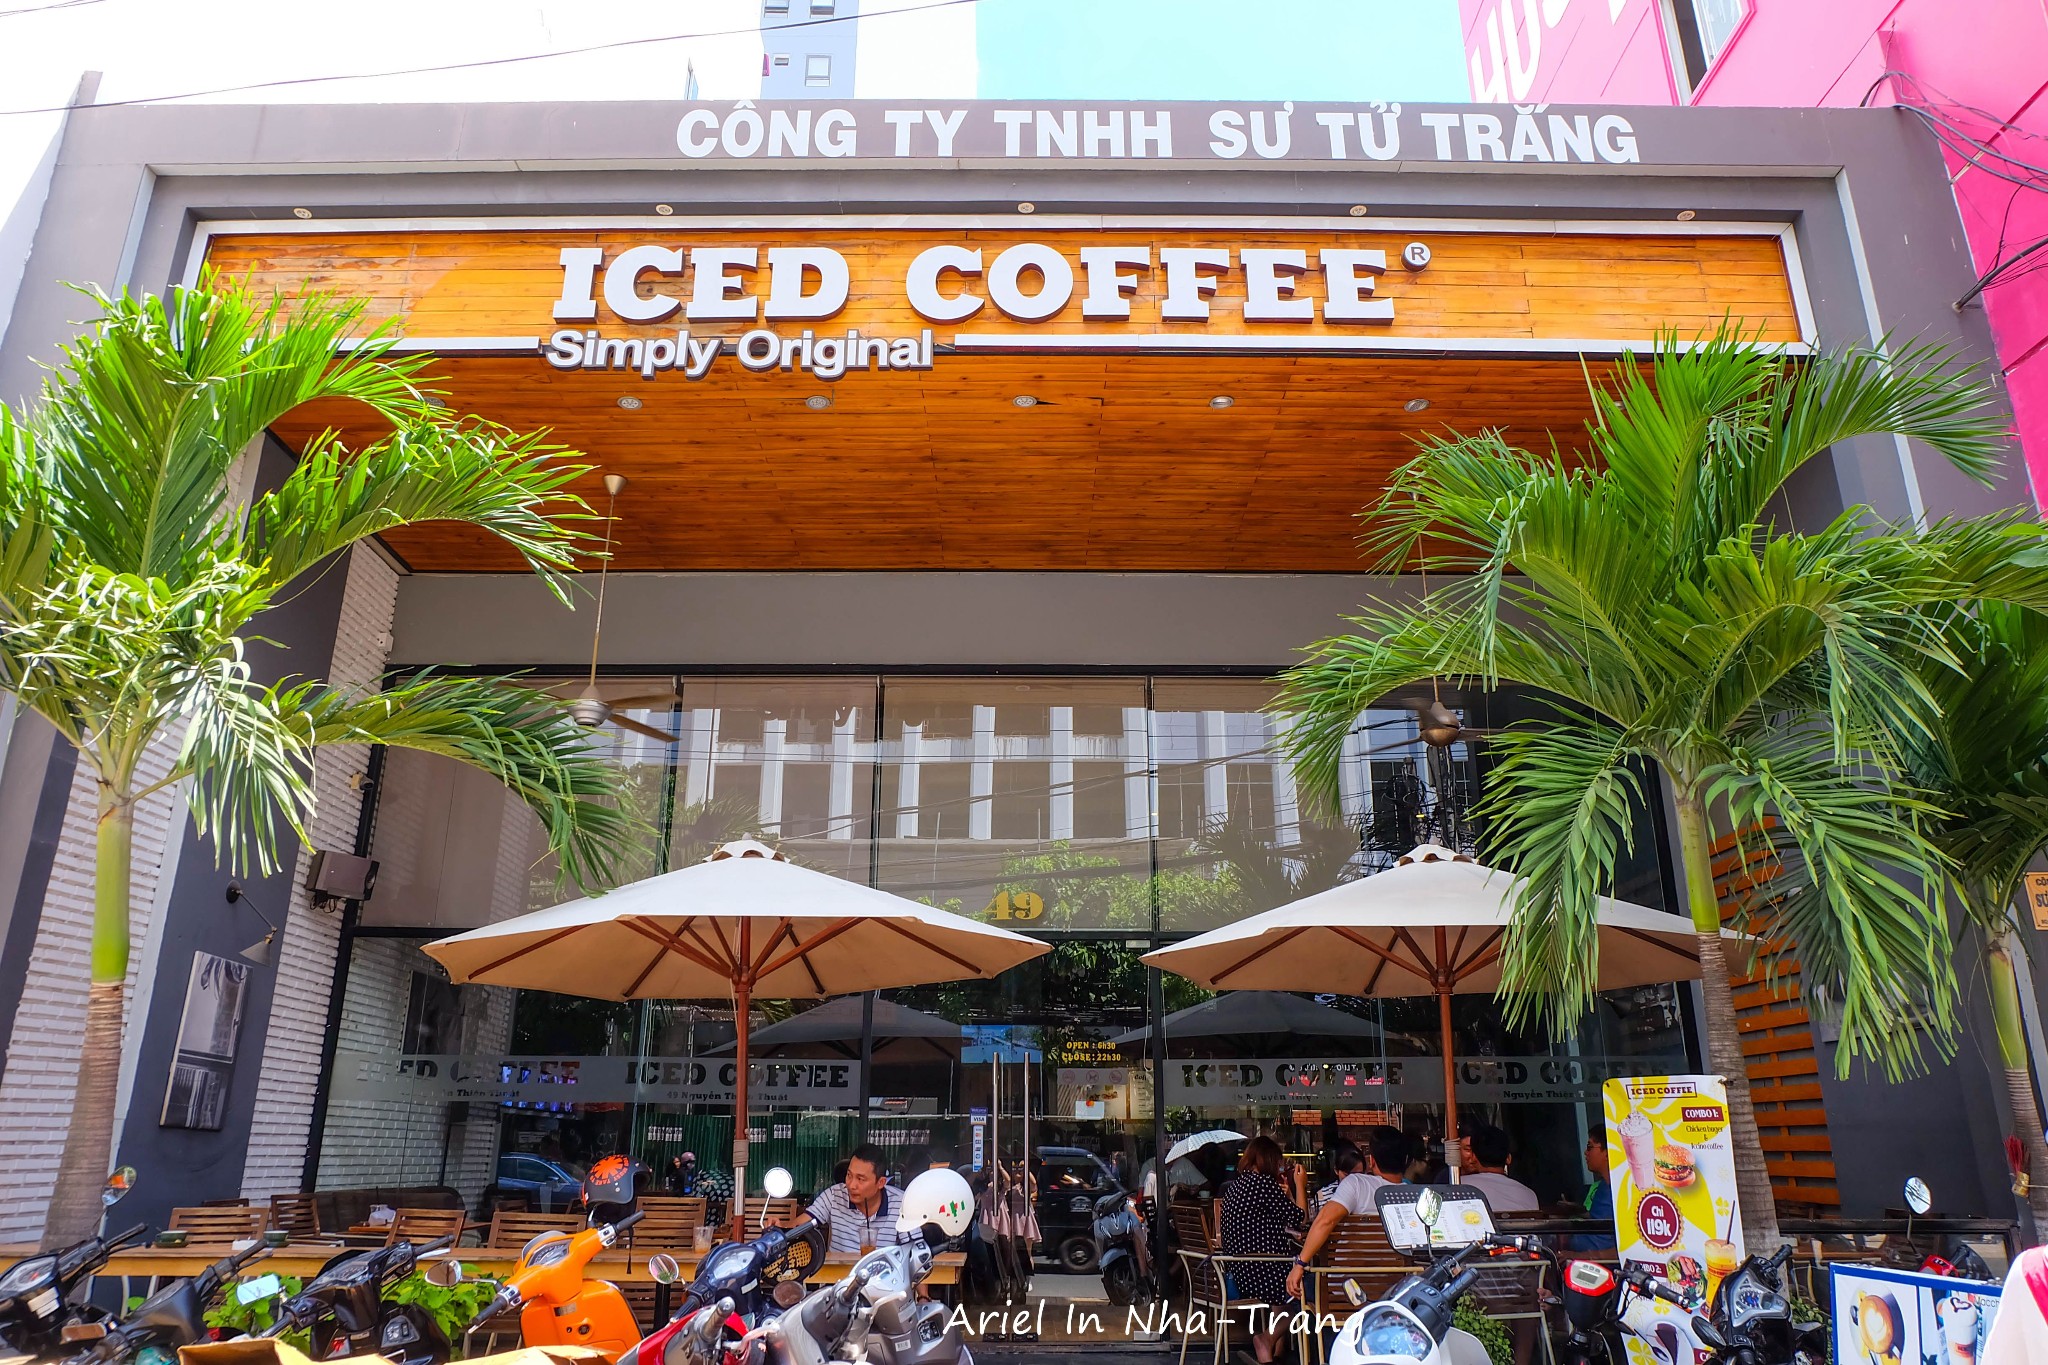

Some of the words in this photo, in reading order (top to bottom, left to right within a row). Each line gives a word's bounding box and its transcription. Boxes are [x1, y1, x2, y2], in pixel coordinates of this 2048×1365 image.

[676, 99, 857, 158] CÔNG
[884, 109, 969, 157] TY
[993, 110, 1173, 157] TNHH
[1207, 101, 1294, 159] SƯ
[1316, 100, 1402, 160] TỬ
[1421, 103, 1640, 163] TRẮNG
[552, 245, 851, 324] ICED
[905, 243, 1395, 325] COFFEE
[546, 328, 723, 381] Simply
[735, 328, 934, 381] Original
[982, 890, 1044, 921] 49
[1066, 1041, 1089, 1050] OPEN
[451, 1060, 580, 1084] CFFEE
[625, 1061, 707, 1086] ICED
[718, 1063, 849, 1088] COFFEE
[1181, 1064, 1264, 1088] ICED
[1631, 1087, 1656, 1096] ICED
[1657, 1085, 1693, 1095] COFFEE
[1685, 1109, 1712, 1119] COMBO
[1646, 1218, 1673, 1237] 119k
